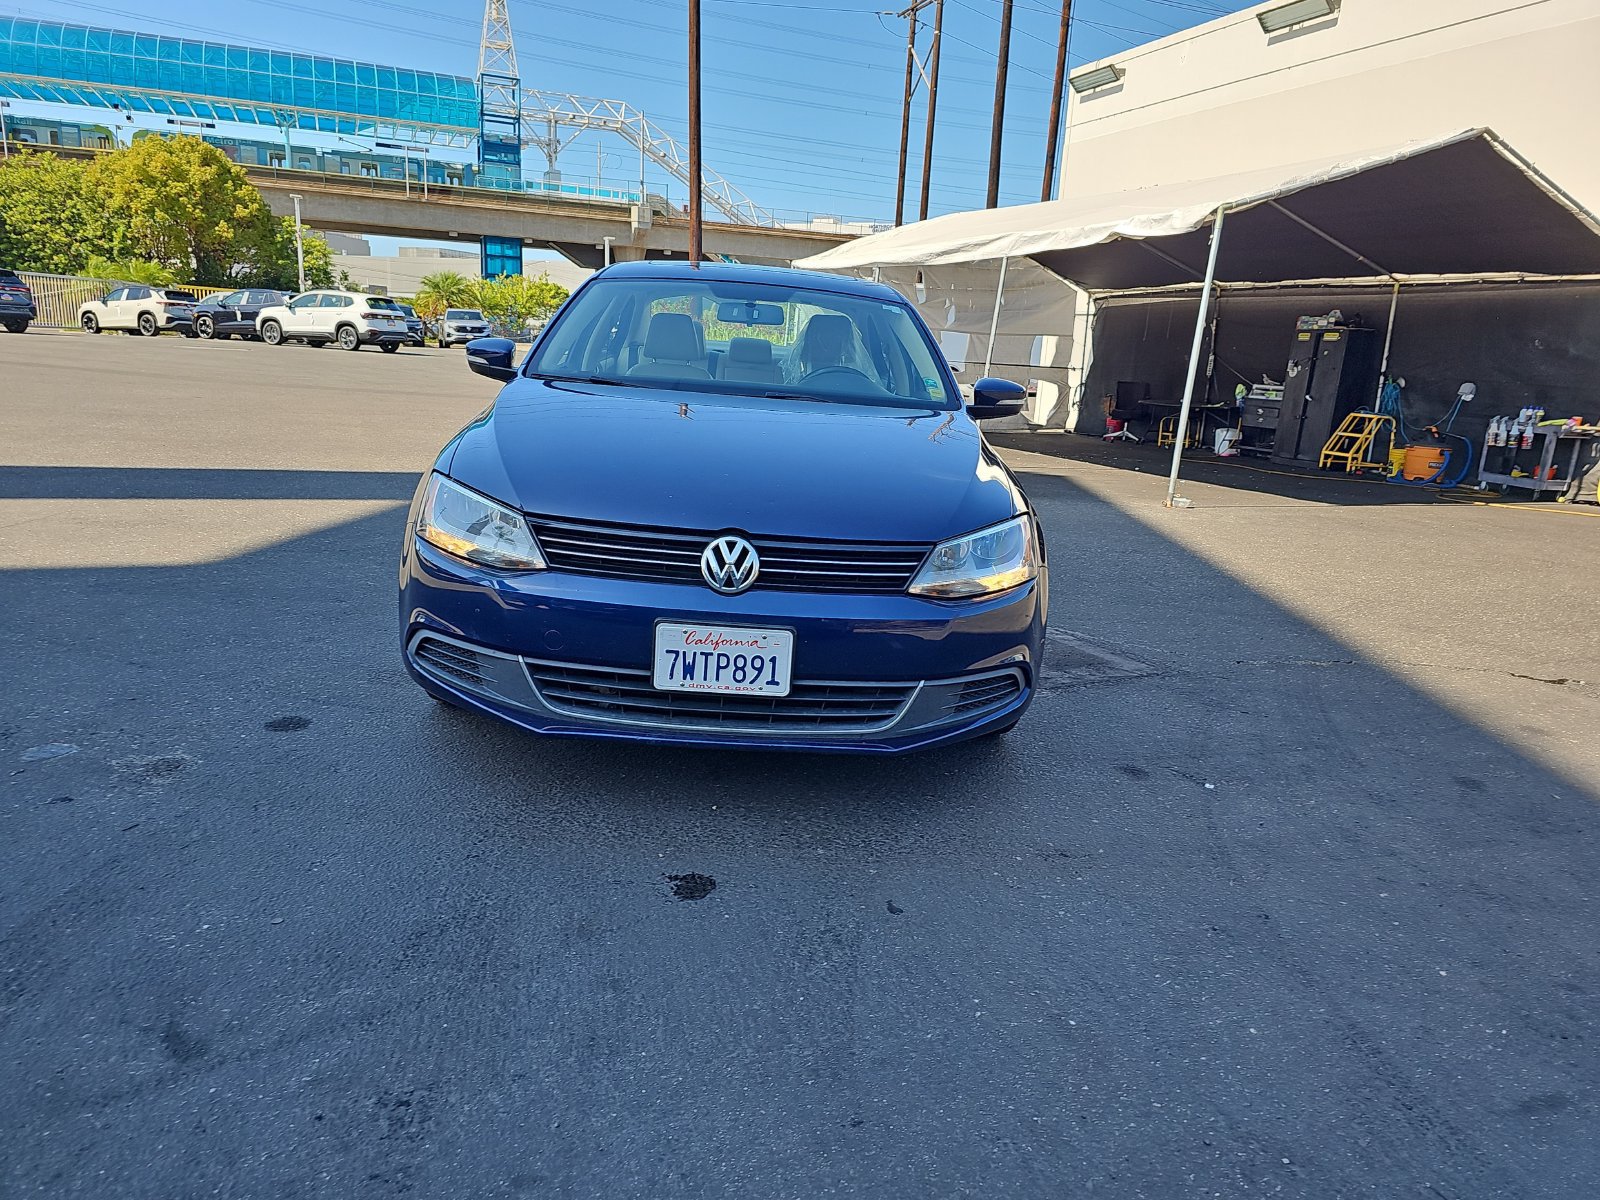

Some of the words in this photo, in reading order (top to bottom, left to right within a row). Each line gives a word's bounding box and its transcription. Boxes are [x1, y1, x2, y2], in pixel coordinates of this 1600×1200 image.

[206, 136, 233, 145] Metro
[685, 630, 767, 651] California
[665, 649, 780, 687] 7WTP891
[688, 682, 756, 691] dmv.ca.gov
